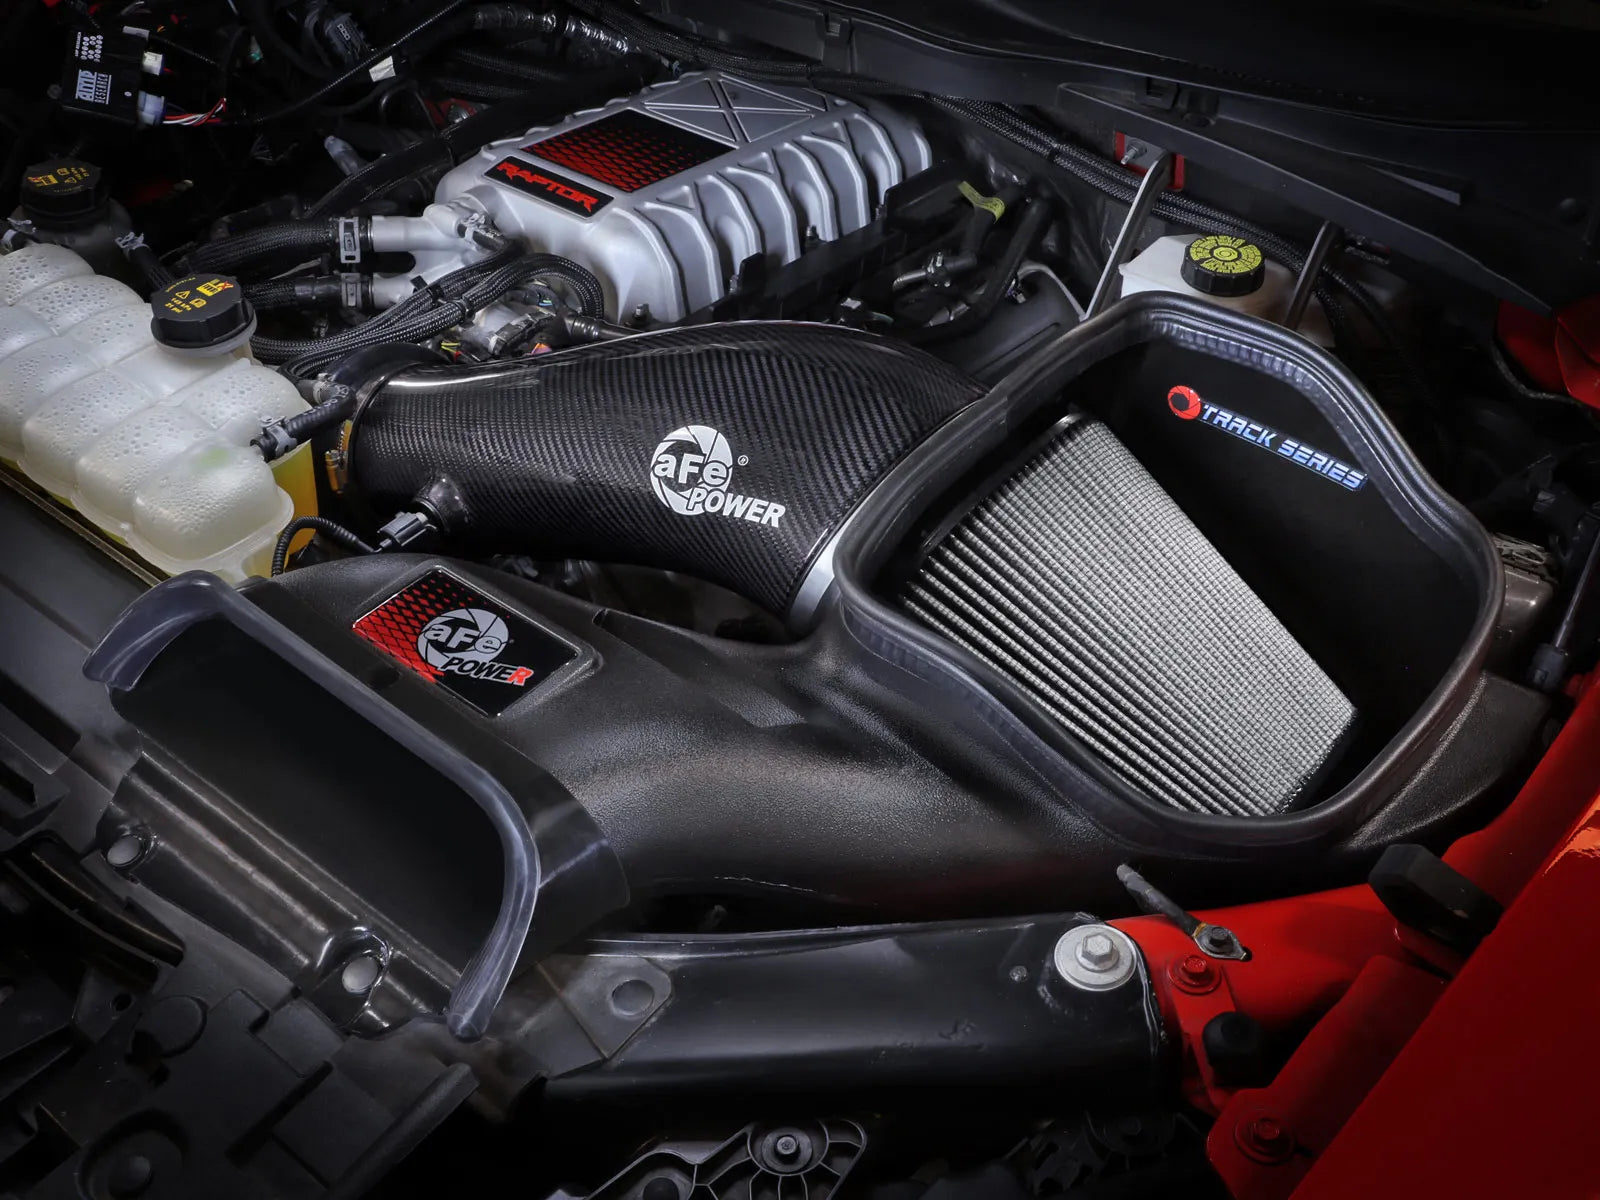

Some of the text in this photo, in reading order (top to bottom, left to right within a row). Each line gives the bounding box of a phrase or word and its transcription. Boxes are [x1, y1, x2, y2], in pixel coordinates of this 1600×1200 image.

[77, 69, 97, 103] AMP
[95, 73, 108, 104] RESEARCH
[496, 161, 599, 213] RAPTOR
[1202, 404, 1365, 488] TRACK SERIES
[653, 452, 728, 487] aFe
[686, 487, 786, 528] POWER
[424, 624, 501, 654] aFe
[437, 656, 534, 687] POWER
